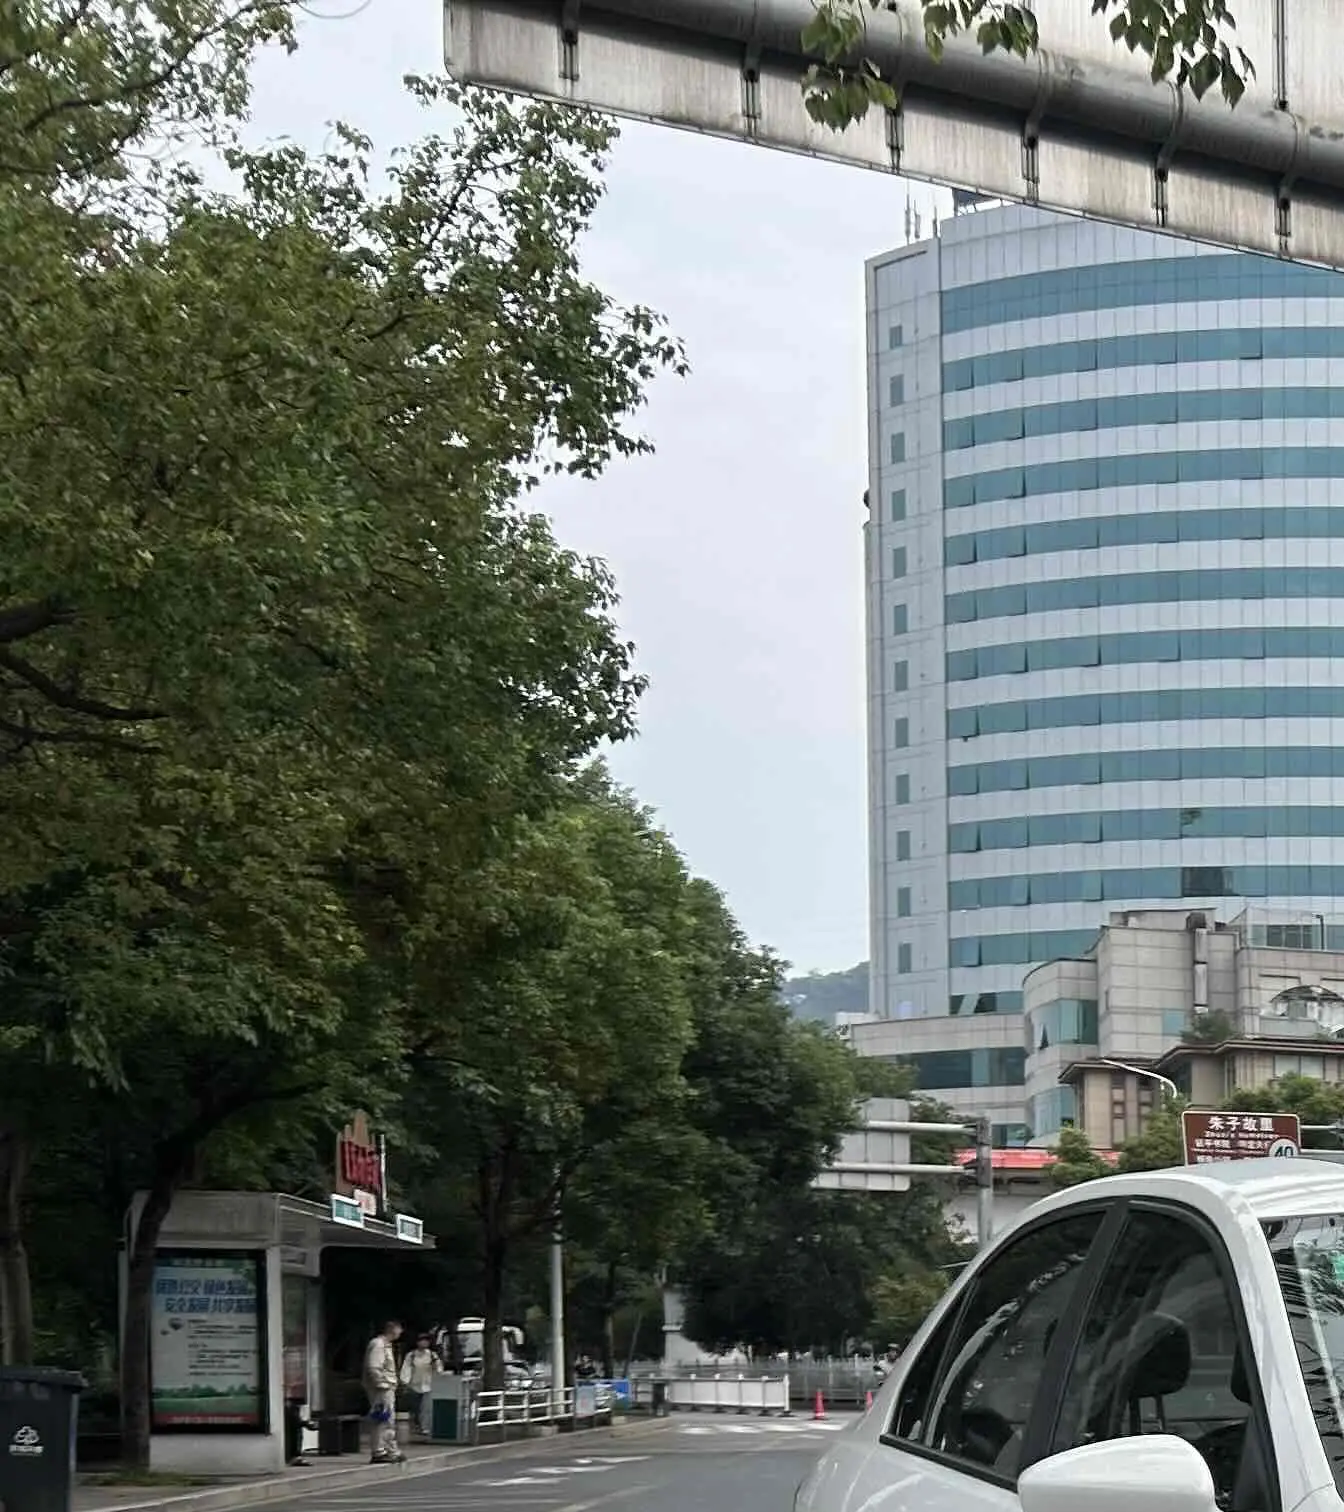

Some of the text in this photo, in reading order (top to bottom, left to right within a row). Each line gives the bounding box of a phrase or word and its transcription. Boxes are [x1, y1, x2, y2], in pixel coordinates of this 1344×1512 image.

[1208, 1116, 1274, 1131] 朱子故里
[1275, 1146, 1294, 1158] 40
